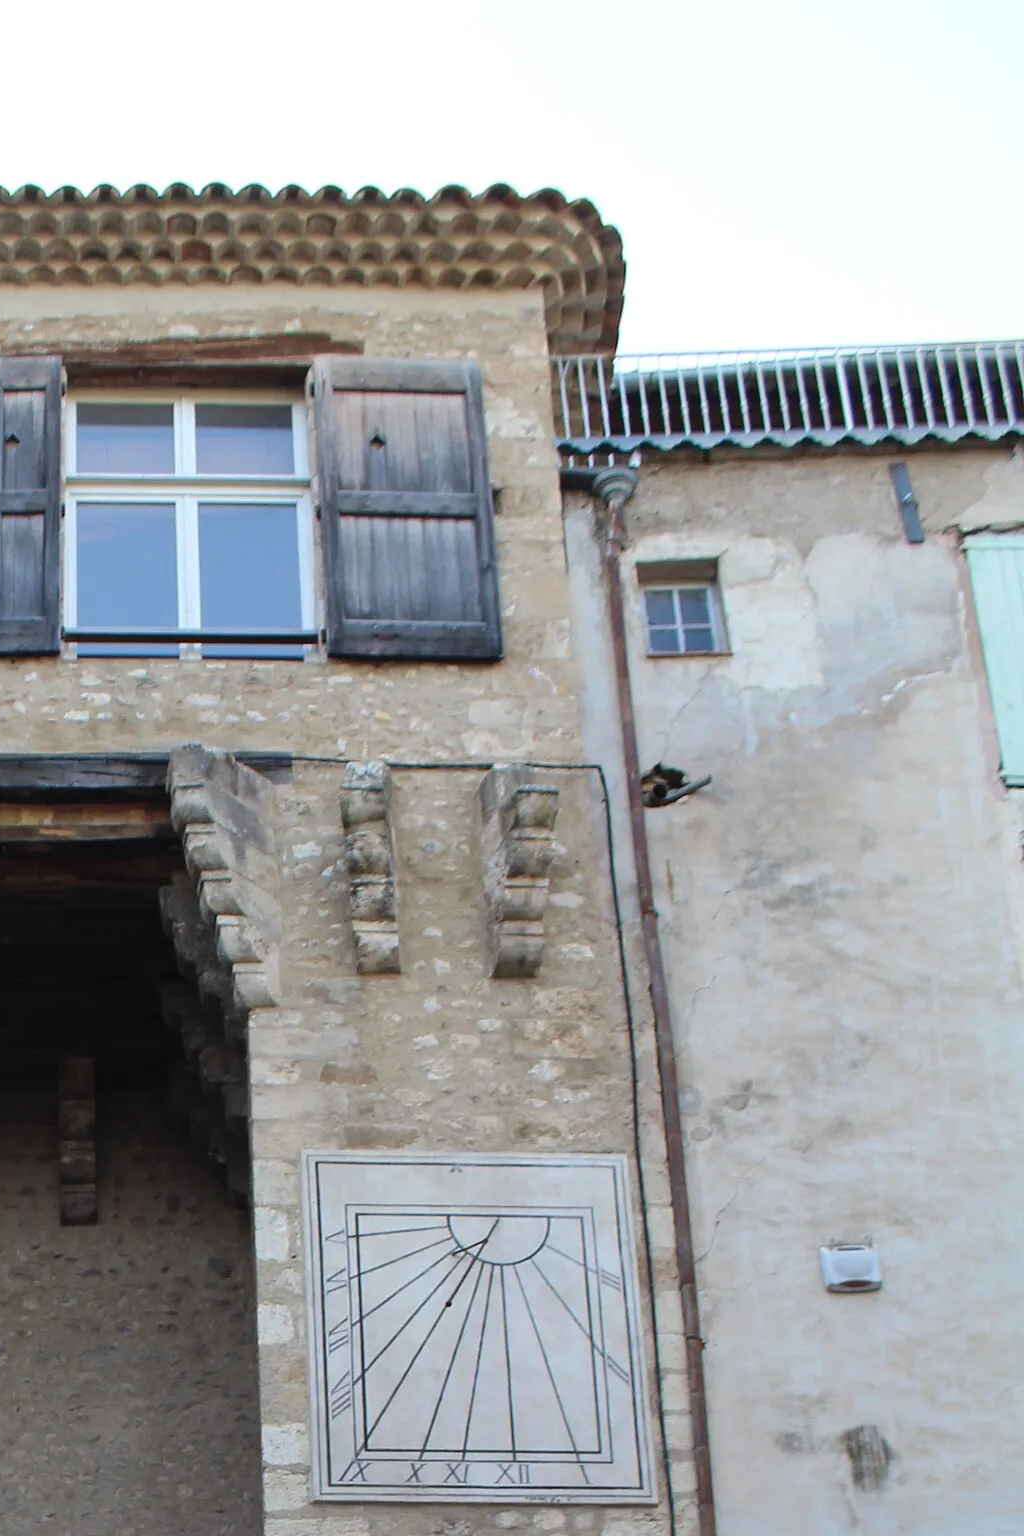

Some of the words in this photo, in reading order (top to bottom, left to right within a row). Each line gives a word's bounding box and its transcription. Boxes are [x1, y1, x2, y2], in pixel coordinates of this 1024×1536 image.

[404, 1462, 426, 1483] X
[442, 1462, 471, 1484] XI
[494, 1463, 531, 1485] XII
